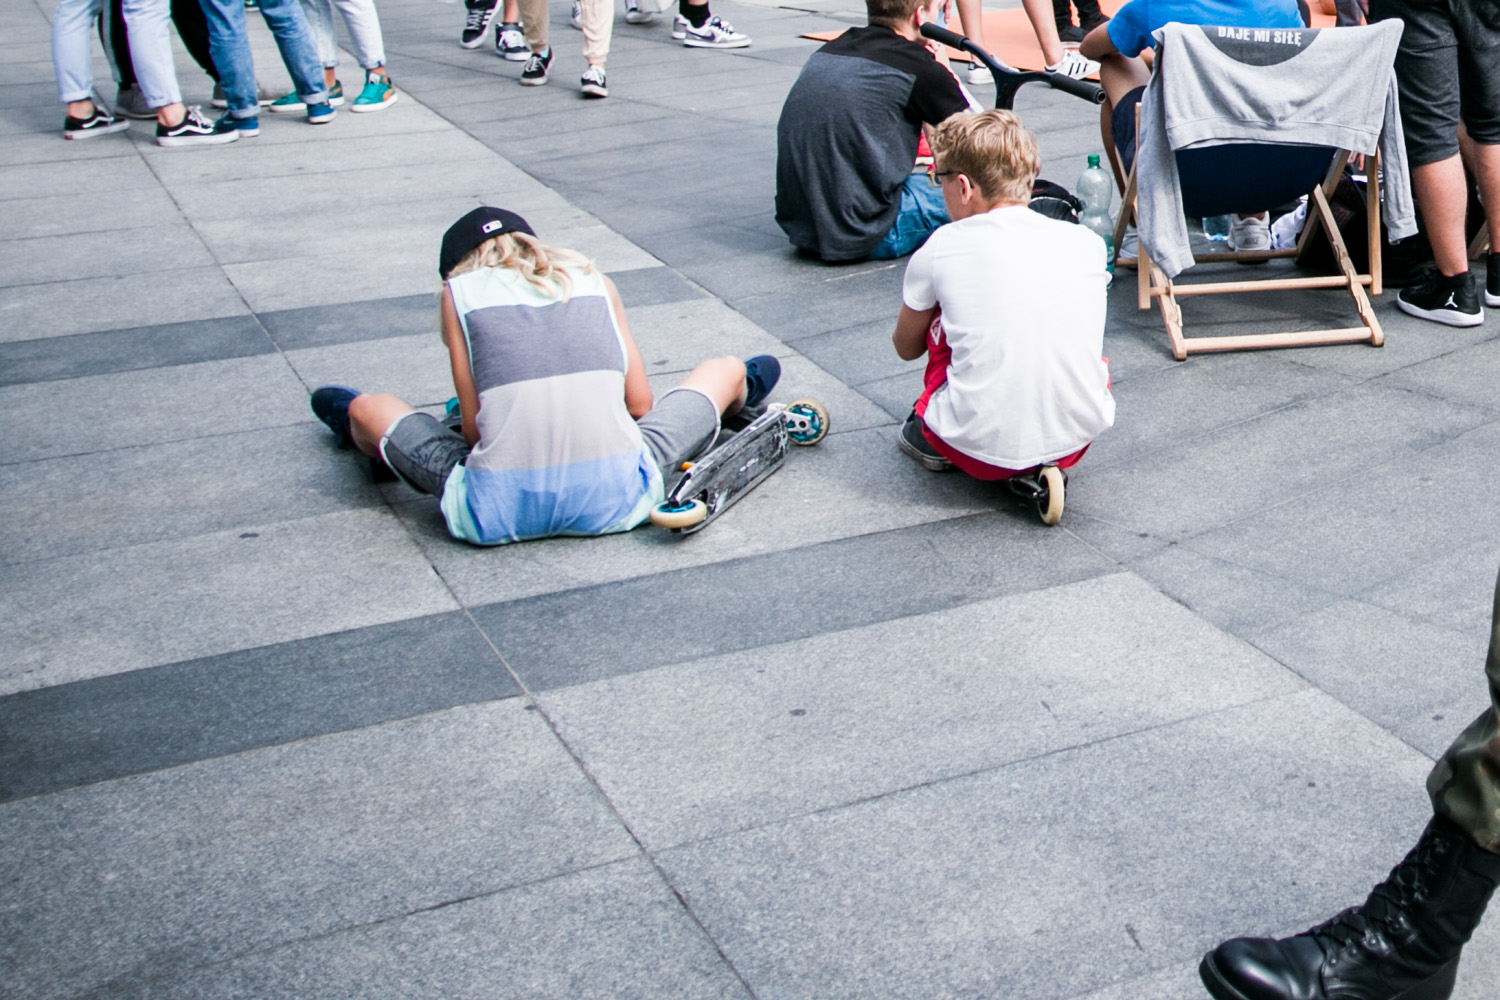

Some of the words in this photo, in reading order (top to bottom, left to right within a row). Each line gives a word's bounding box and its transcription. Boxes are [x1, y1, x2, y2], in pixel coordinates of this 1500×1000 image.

[1218, 26, 1250, 41] DAJE
[1254, 30, 1270, 42] MI
[1273, 31, 1302, 47] SIŁĘ
